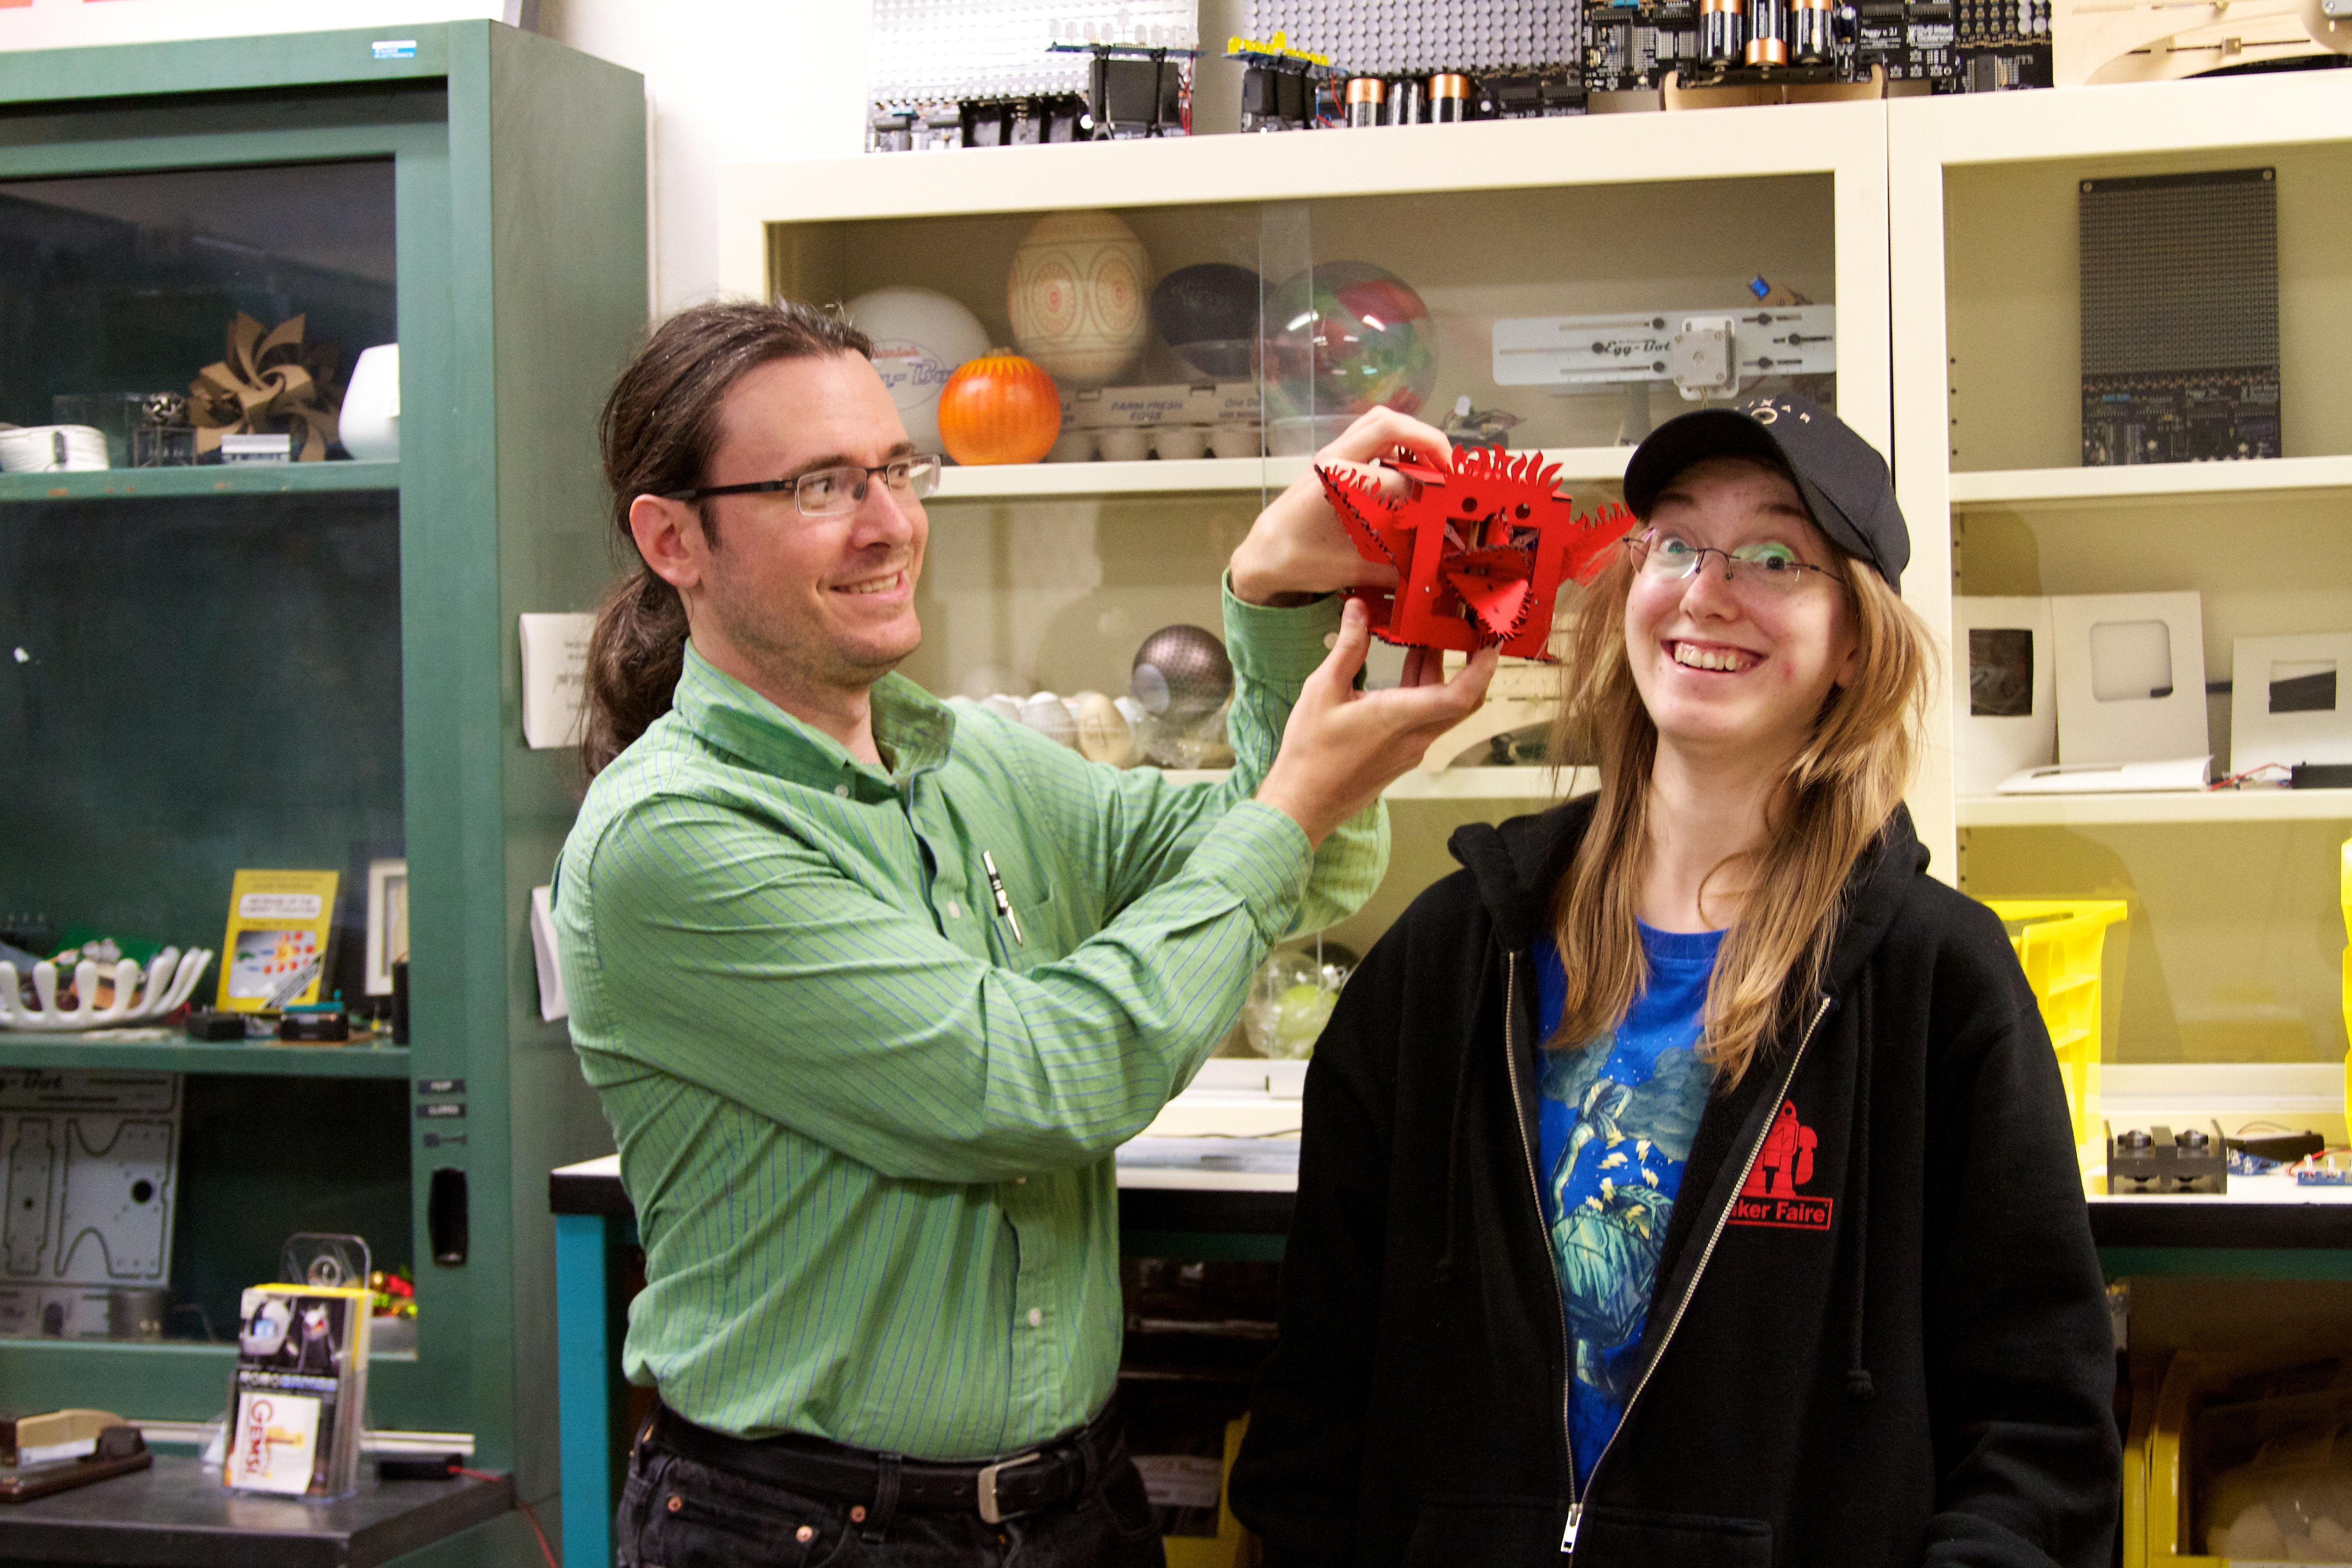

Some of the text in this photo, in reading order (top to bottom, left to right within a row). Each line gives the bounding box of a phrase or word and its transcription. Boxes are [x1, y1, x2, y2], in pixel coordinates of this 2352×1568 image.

[1604, 339, 1670, 357] Egg-Bot
[1111, 401, 1183, 411] FARM FRESH
[1775, 1201, 1825, 1223] Faire
